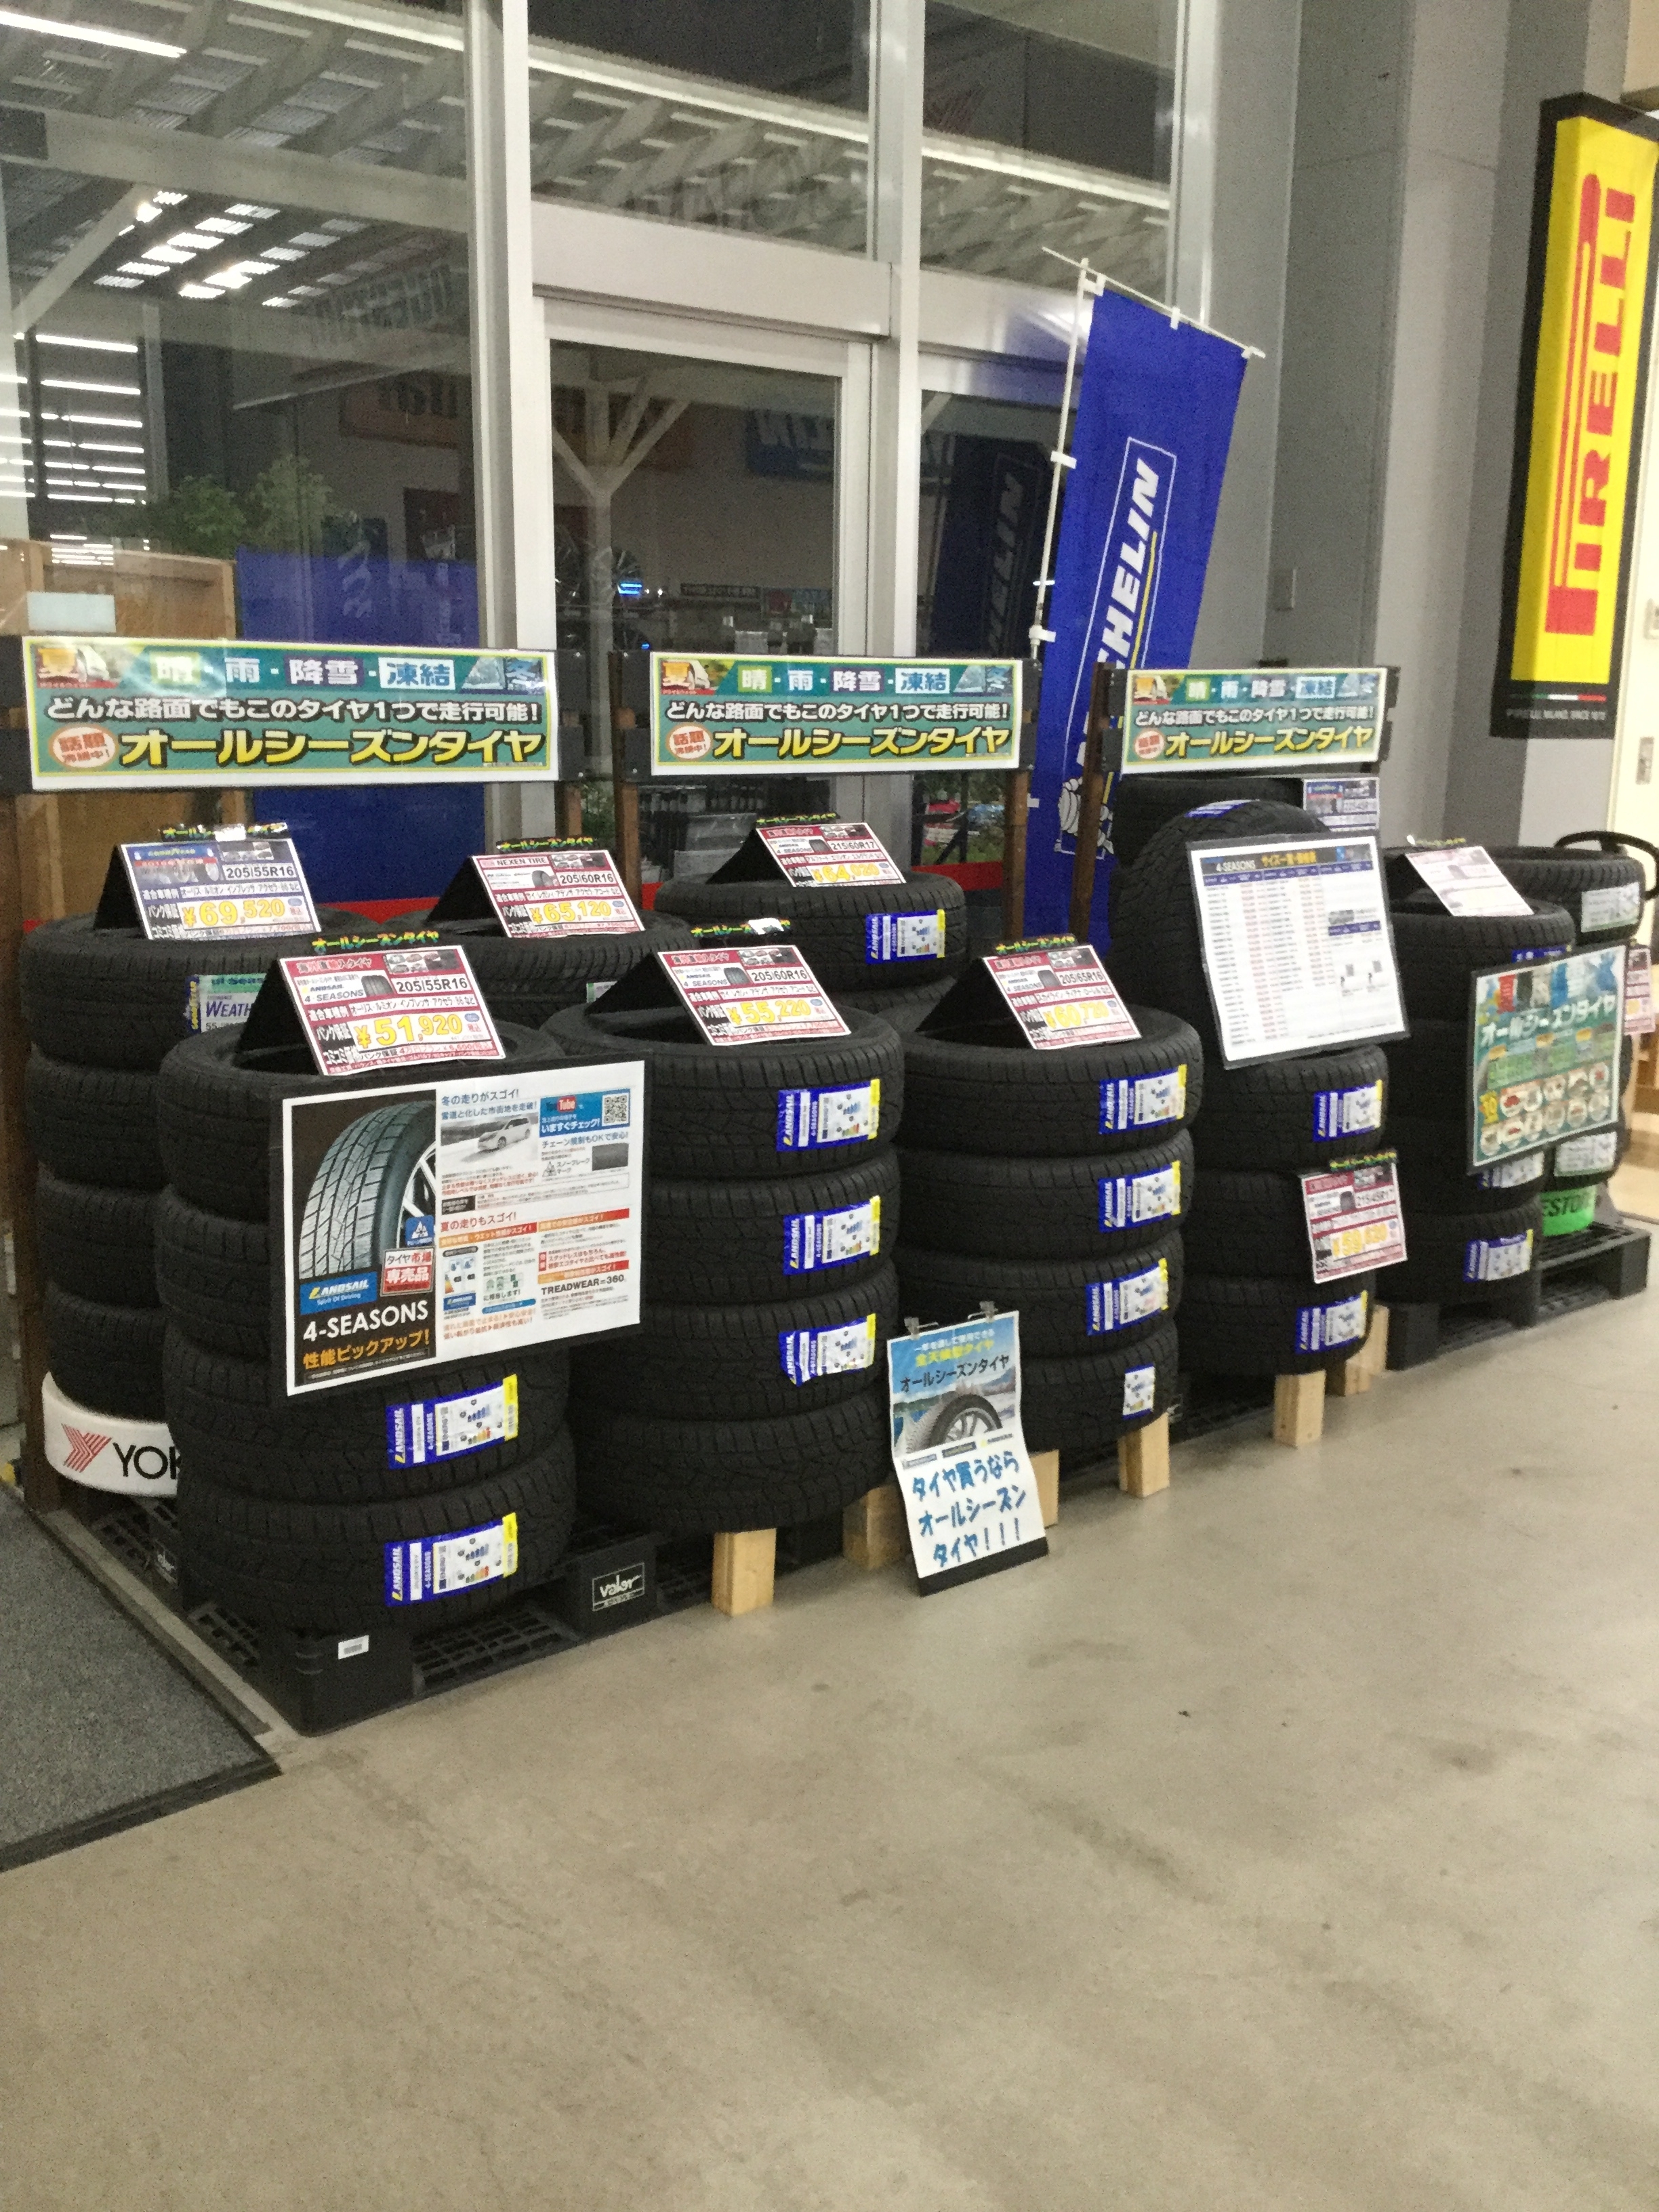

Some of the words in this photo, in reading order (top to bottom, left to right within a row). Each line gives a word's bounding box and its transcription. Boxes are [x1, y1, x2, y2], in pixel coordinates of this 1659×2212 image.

[1544, 173, 1635, 634] PIRELLI
[122, 730, 544, 765] オールシーズンタイヤ
[714, 727, 1009, 757] オールシーズンタイヤ
[1165, 726, 1374, 757] オールシーズンタイヤ
[354, 1014, 463, 1049] ¥51,920
[303, 1300, 429, 1342] 4-SEASONS
[303, 1328, 430, 1370] 性能ピックアップ!
[900, 1354, 1010, 1393] オールシーズンタイヤ
[912, 1450, 1020, 1502] タイヤ買うなら
[918, 1485, 1027, 1537] オールシーズン
